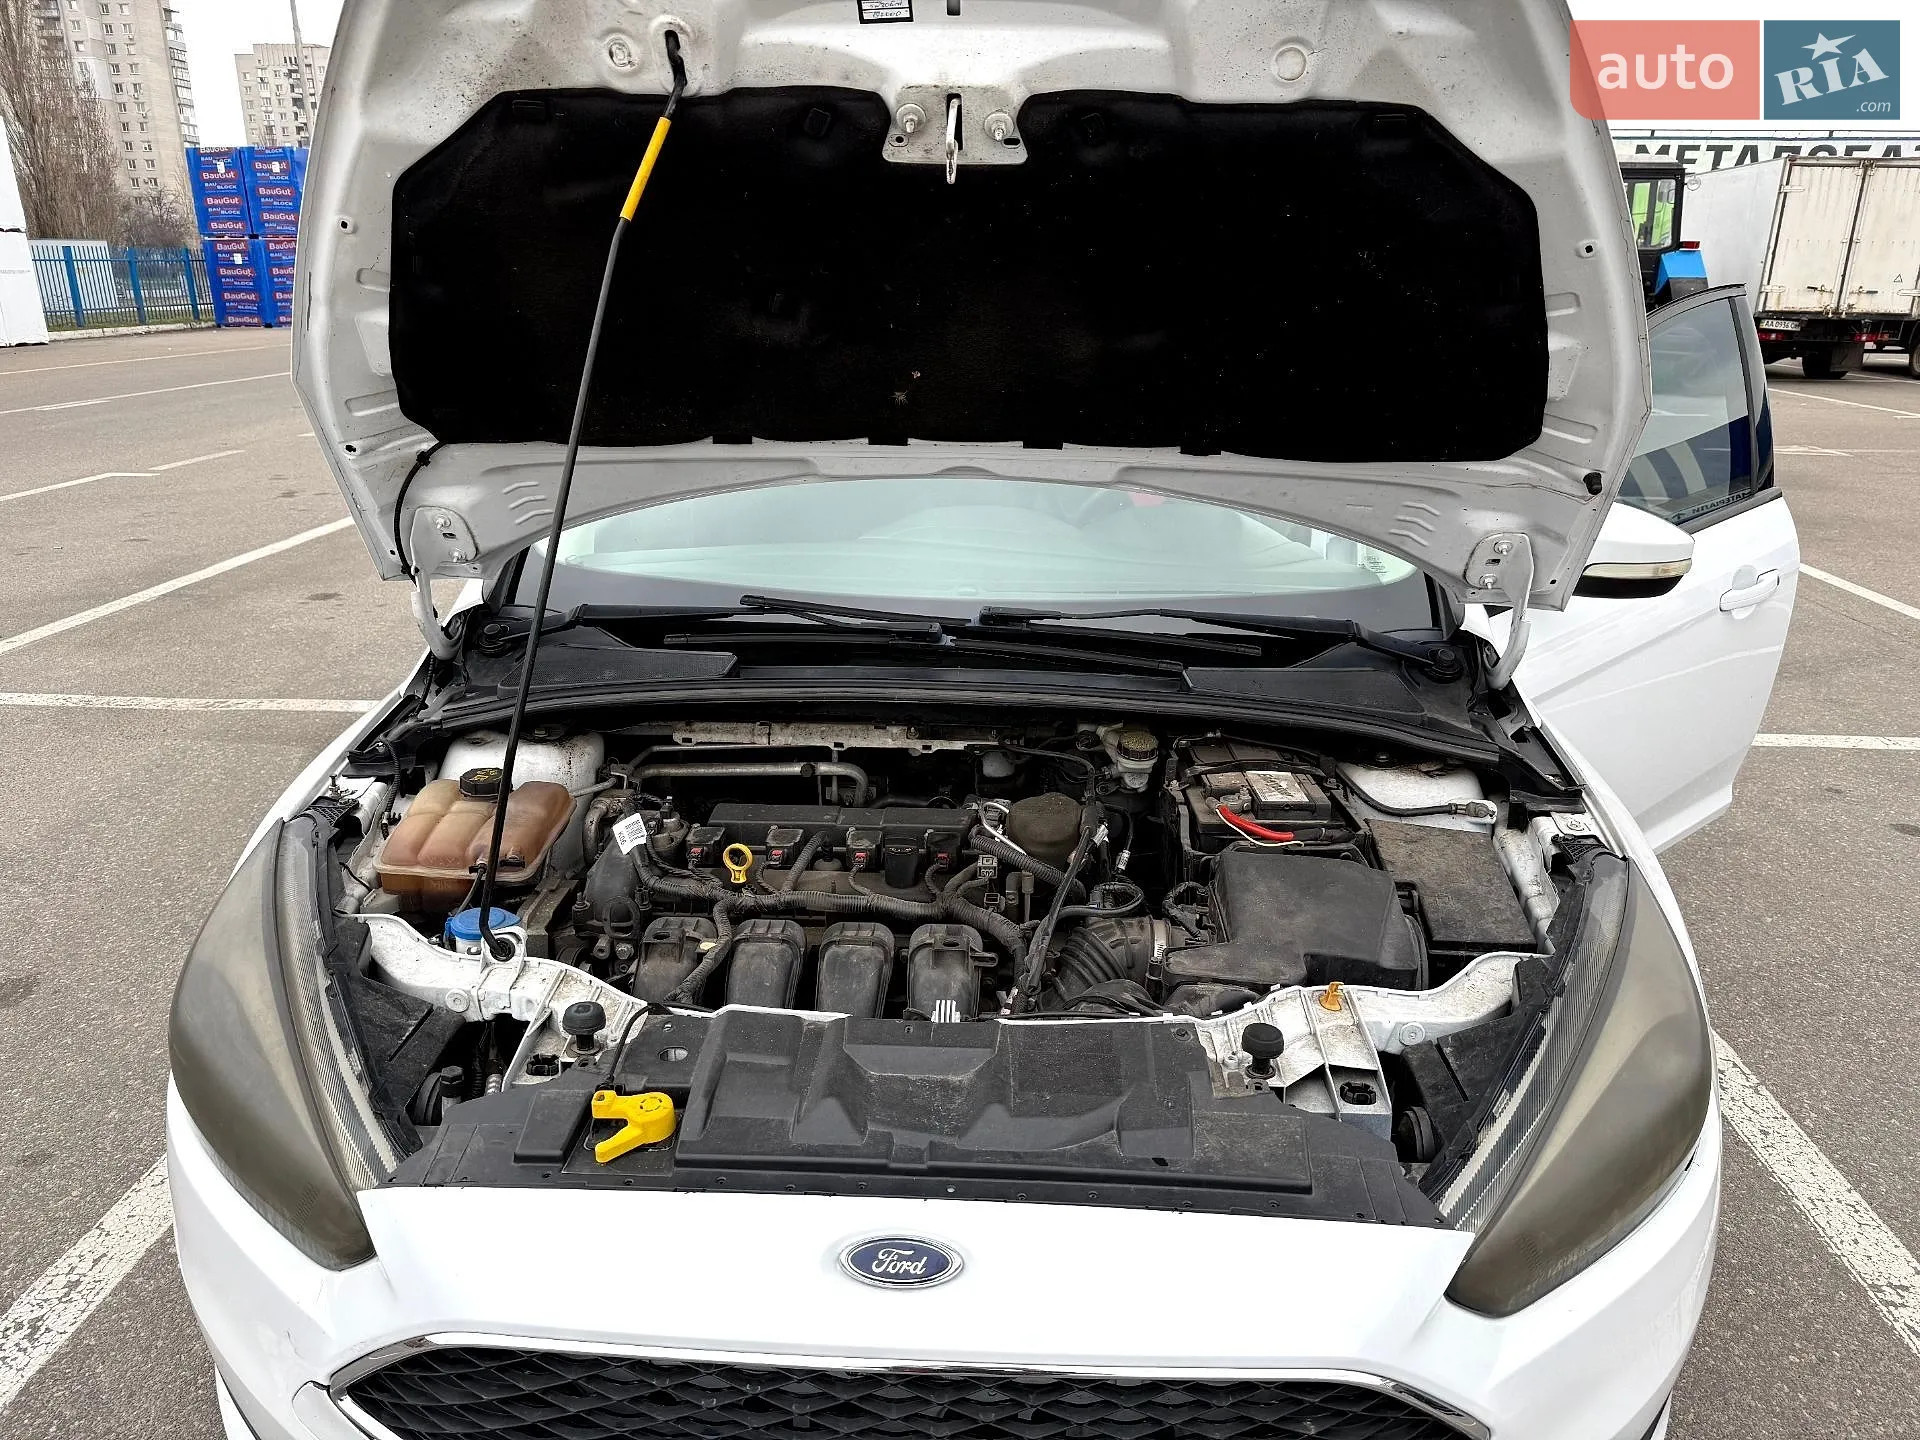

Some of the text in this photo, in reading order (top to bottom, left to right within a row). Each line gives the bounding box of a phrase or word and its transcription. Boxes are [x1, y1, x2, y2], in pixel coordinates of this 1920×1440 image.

[202, 171, 235, 179] BauGut
[259, 188, 292, 196] BauGut
[207, 197, 239, 205] BauGut
[263, 213, 295, 221] BauGut
[217, 242, 245, 251] BauGut
[224, 292, 256, 300] BauGut
[871, 1248, 928, 1275] Ford
